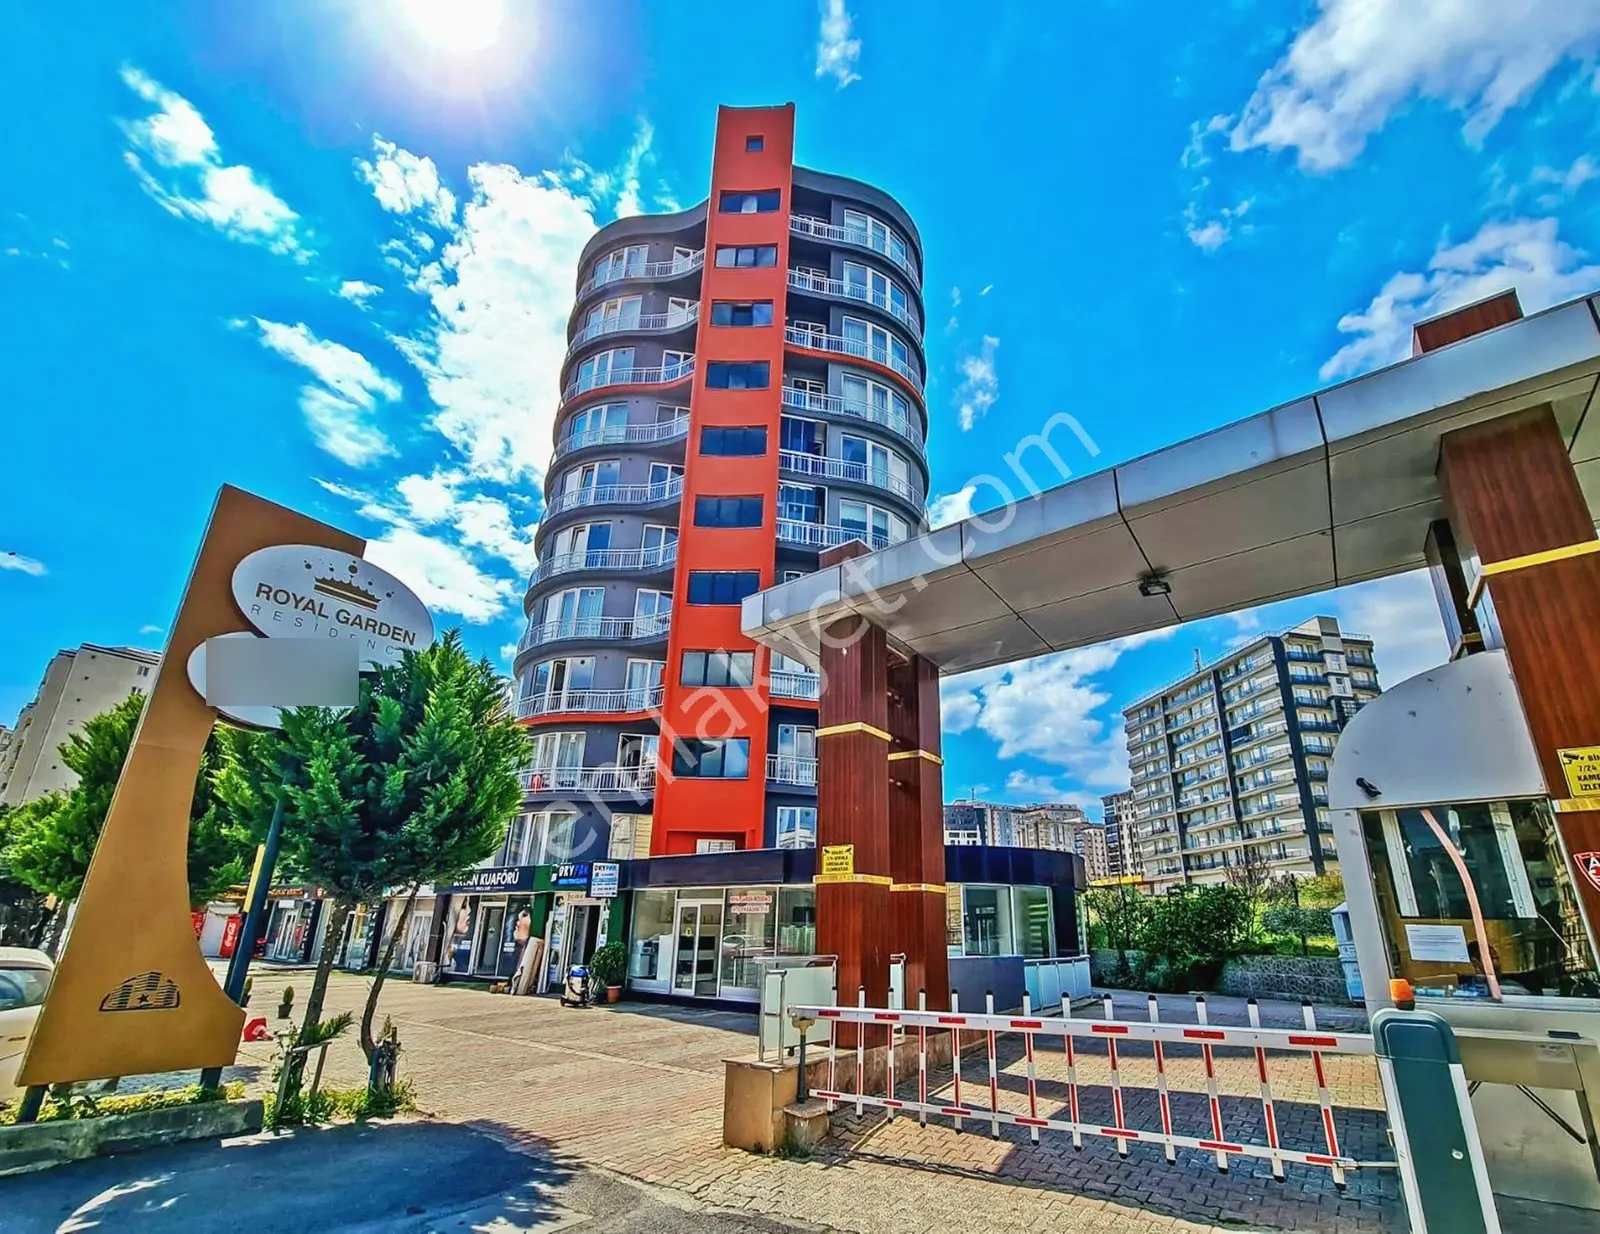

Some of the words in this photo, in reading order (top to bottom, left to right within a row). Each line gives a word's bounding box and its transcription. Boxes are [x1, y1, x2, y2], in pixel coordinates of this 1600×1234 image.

[250, 604, 400, 656] RESIDNC
[255, 582, 329, 619] ROYAL
[335, 609, 416, 646] GARDEN
[480, 868, 519, 886] KUAFÖRÜ
